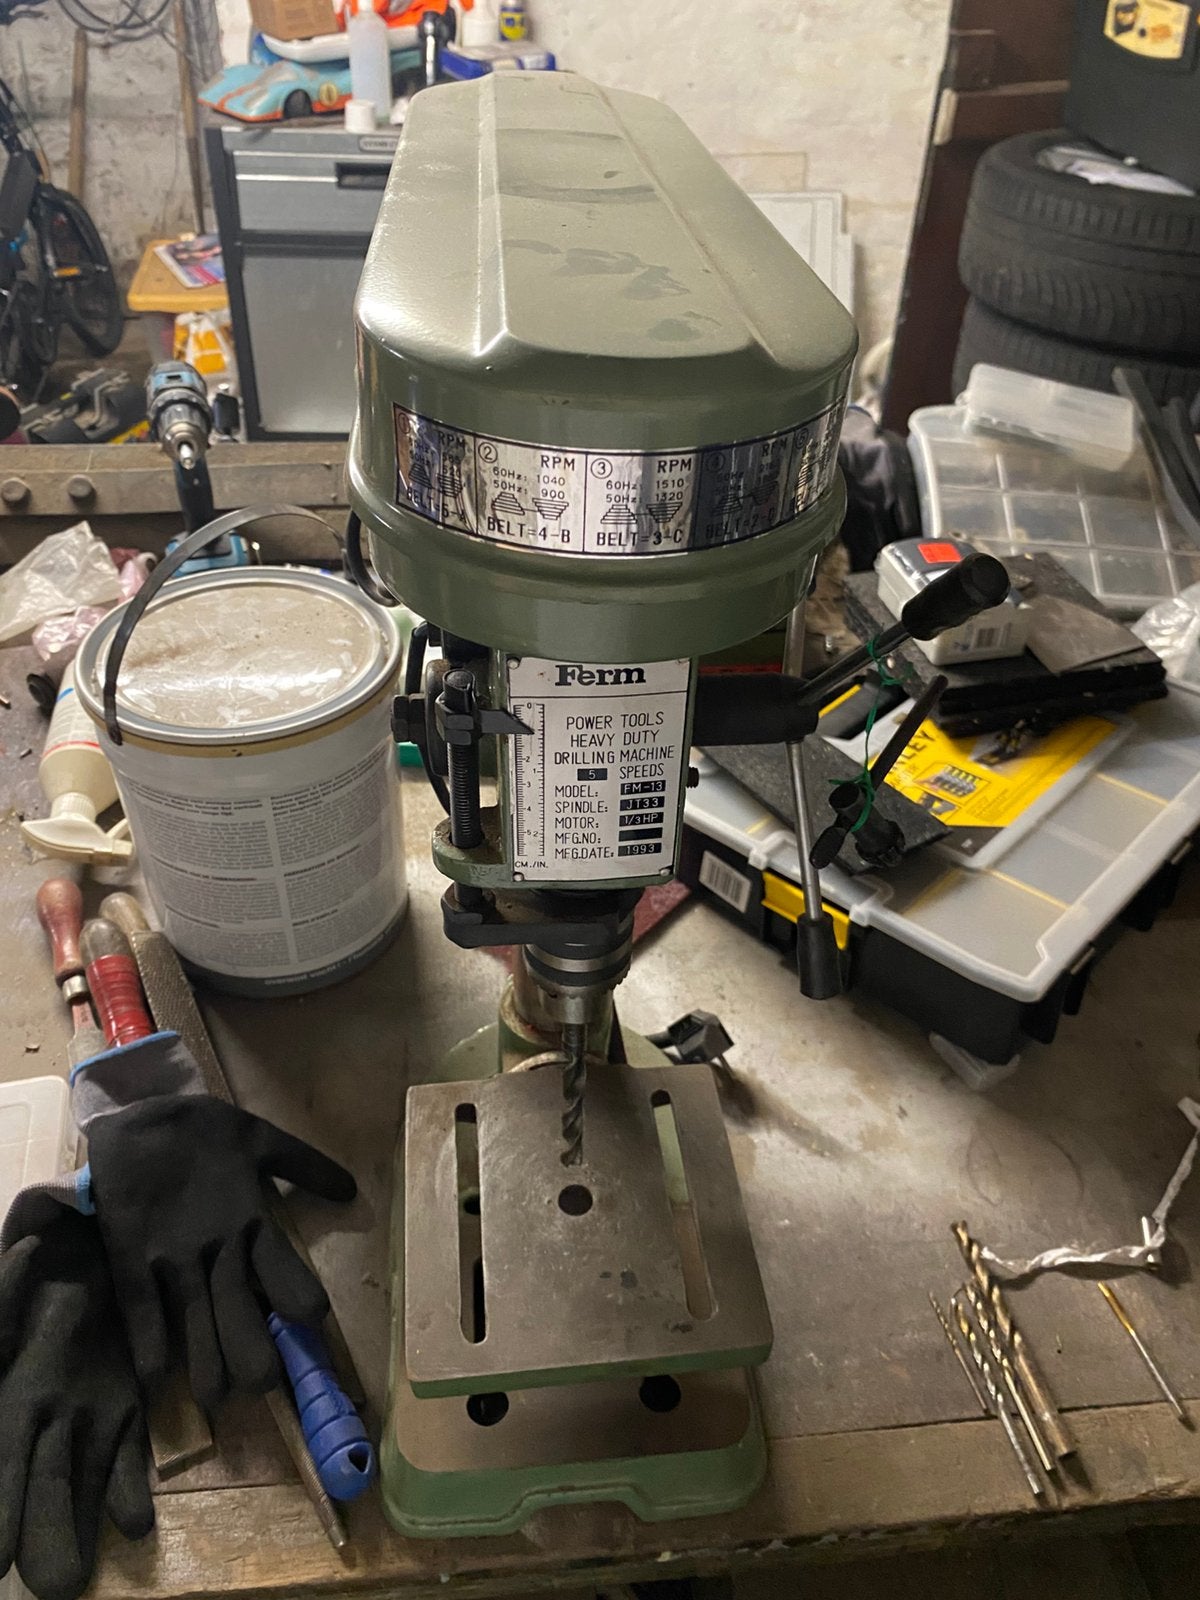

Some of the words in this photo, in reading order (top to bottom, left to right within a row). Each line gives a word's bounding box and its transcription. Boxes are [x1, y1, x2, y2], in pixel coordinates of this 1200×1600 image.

[541, 454, 576, 472] RPM
[657, 458, 692, 474] RPM
[492, 466, 528, 482] 60Hz:
[537, 474, 566, 487] 1040
[656, 478, 685, 490] 1510
[493, 480, 528, 495] 50Hz:
[541, 488, 565, 500] 900
[655, 491, 684, 502] 1320
[554, 664, 647, 687] Ferm
[526, 702, 533, 710] 0
[566, 715, 613, 731] POWER
[620, 711, 665, 728] TOOLS
[570, 733, 616, 748] HEAVY
[623, 729, 660, 746] DUTY
[554, 751, 615, 765] DRILLING
[619, 745, 676, 763] MACHINE
[587, 769, 597, 780] 5
[619, 763, 665, 780] SPEEDS
[554, 784, 599, 799] MODEL:
[623, 781, 664, 795] FM-13
[554, 801, 609, 814] SPINDLE:
[626, 798, 660, 811] JT33
[554, 816, 600, 829] MOTOR:
[554, 832, 602, 845] MFG.NO:
[554, 847, 615, 861] MFG.DATE:
[625, 844, 656, 856] 1993
